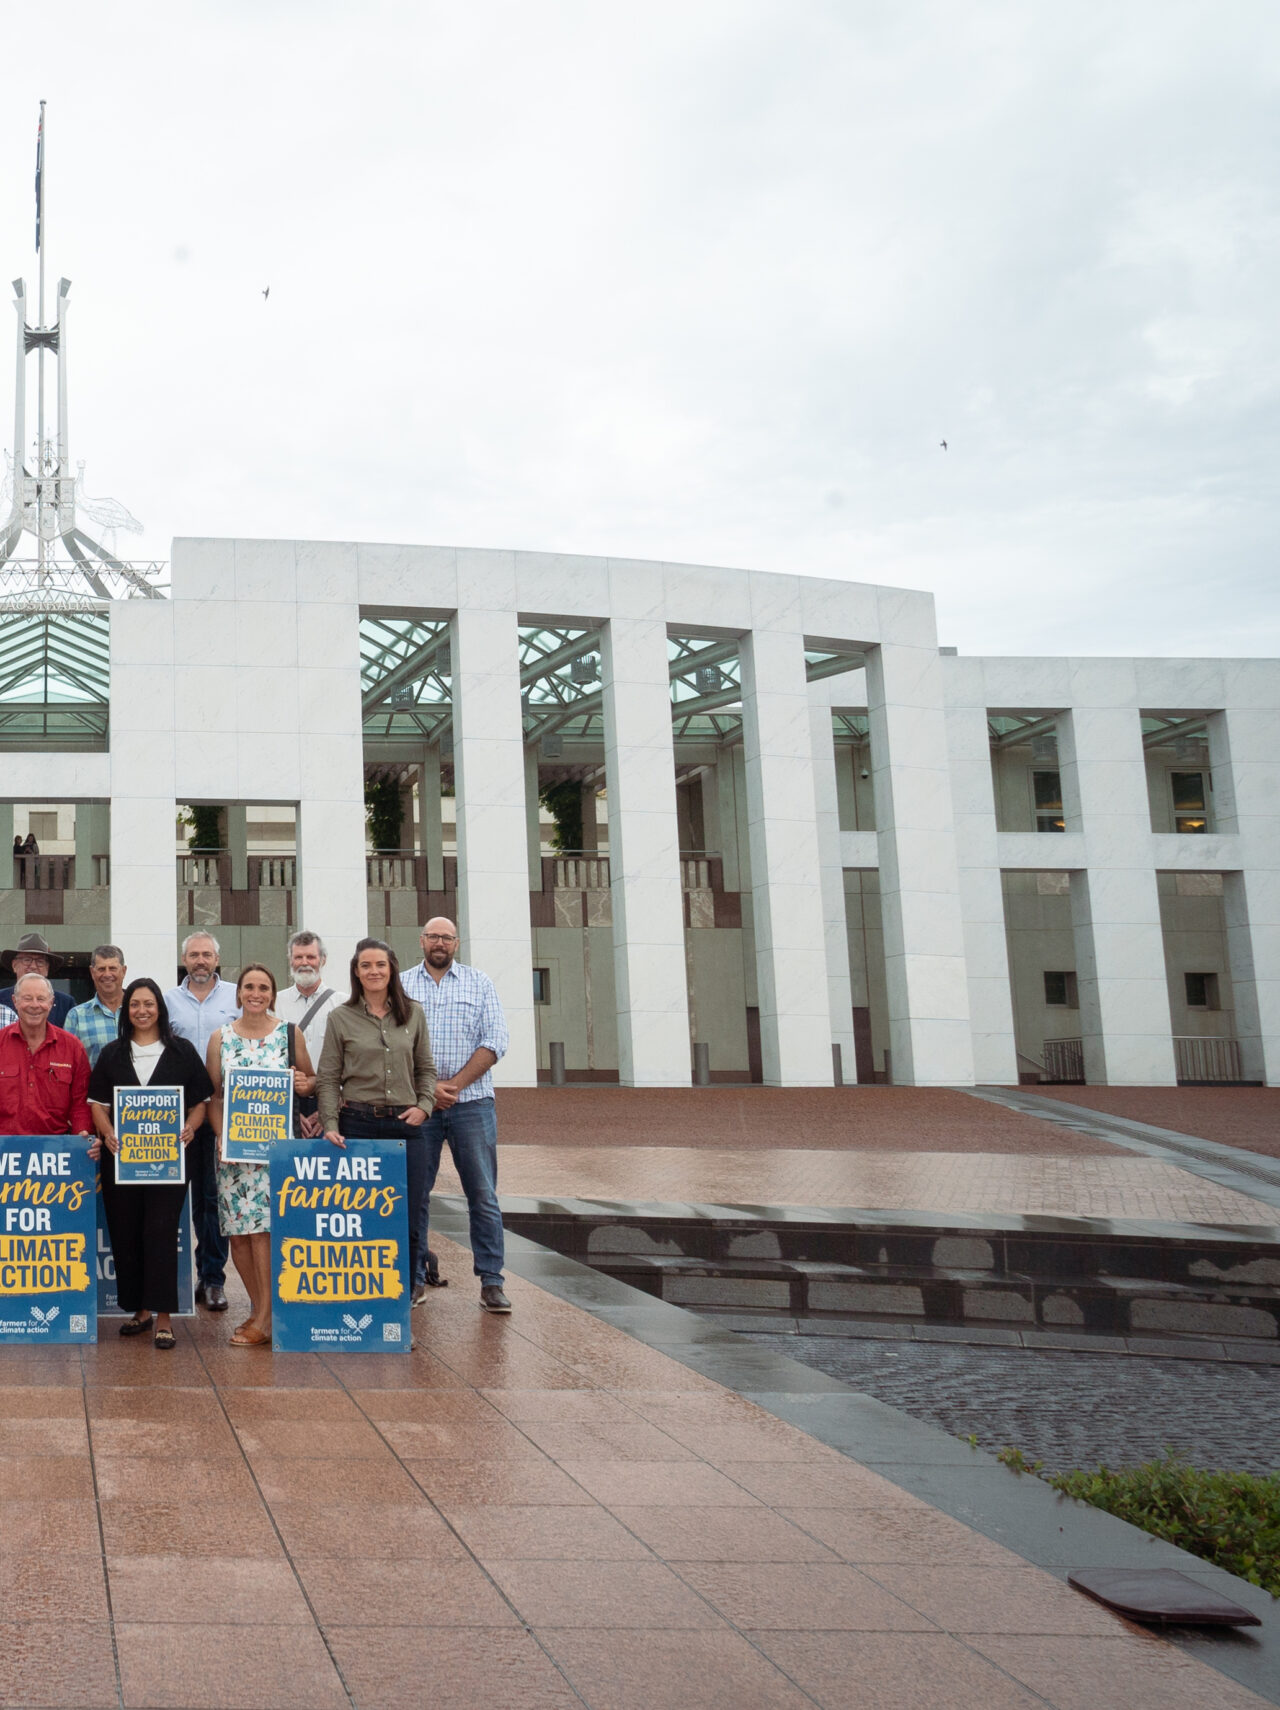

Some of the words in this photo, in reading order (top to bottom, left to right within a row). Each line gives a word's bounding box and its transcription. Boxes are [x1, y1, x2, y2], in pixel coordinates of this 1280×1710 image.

[6, 601, 90, 611] AUSTRALIA
[229, 1074, 234, 1086] I
[236, 1075, 289, 1089] SUPPORT
[119, 1095, 123, 1107] I
[125, 1095, 178, 1107] SUPPORT
[232, 1085, 288, 1105] farmers
[121, 1105, 179, 1125] farmers
[248, 1102, 270, 1114] FOR
[138, 1123, 160, 1134] FOR
[234, 1115, 282, 1129] CLIMATE
[237, 1128, 279, 1140] ACTION
[125, 1136, 174, 1148] CLIMATE
[128, 1149, 170, 1160] ACTION
[26, 1152, 71, 1176] ARE
[294, 1156, 331, 1180] WE
[336, 1157, 382, 1181] ARE
[277, 1176, 403, 1217] farmers
[6, 1208, 51, 1232] FOR
[316, 1213, 363, 1237] FOR
[289, 1245, 391, 1269] CLIMATE
[296, 1272, 384, 1295] ACTION
[311, 1327, 339, 1335] farmers
[340, 1327, 350, 1335] for
[339, 1334, 362, 1342] action
